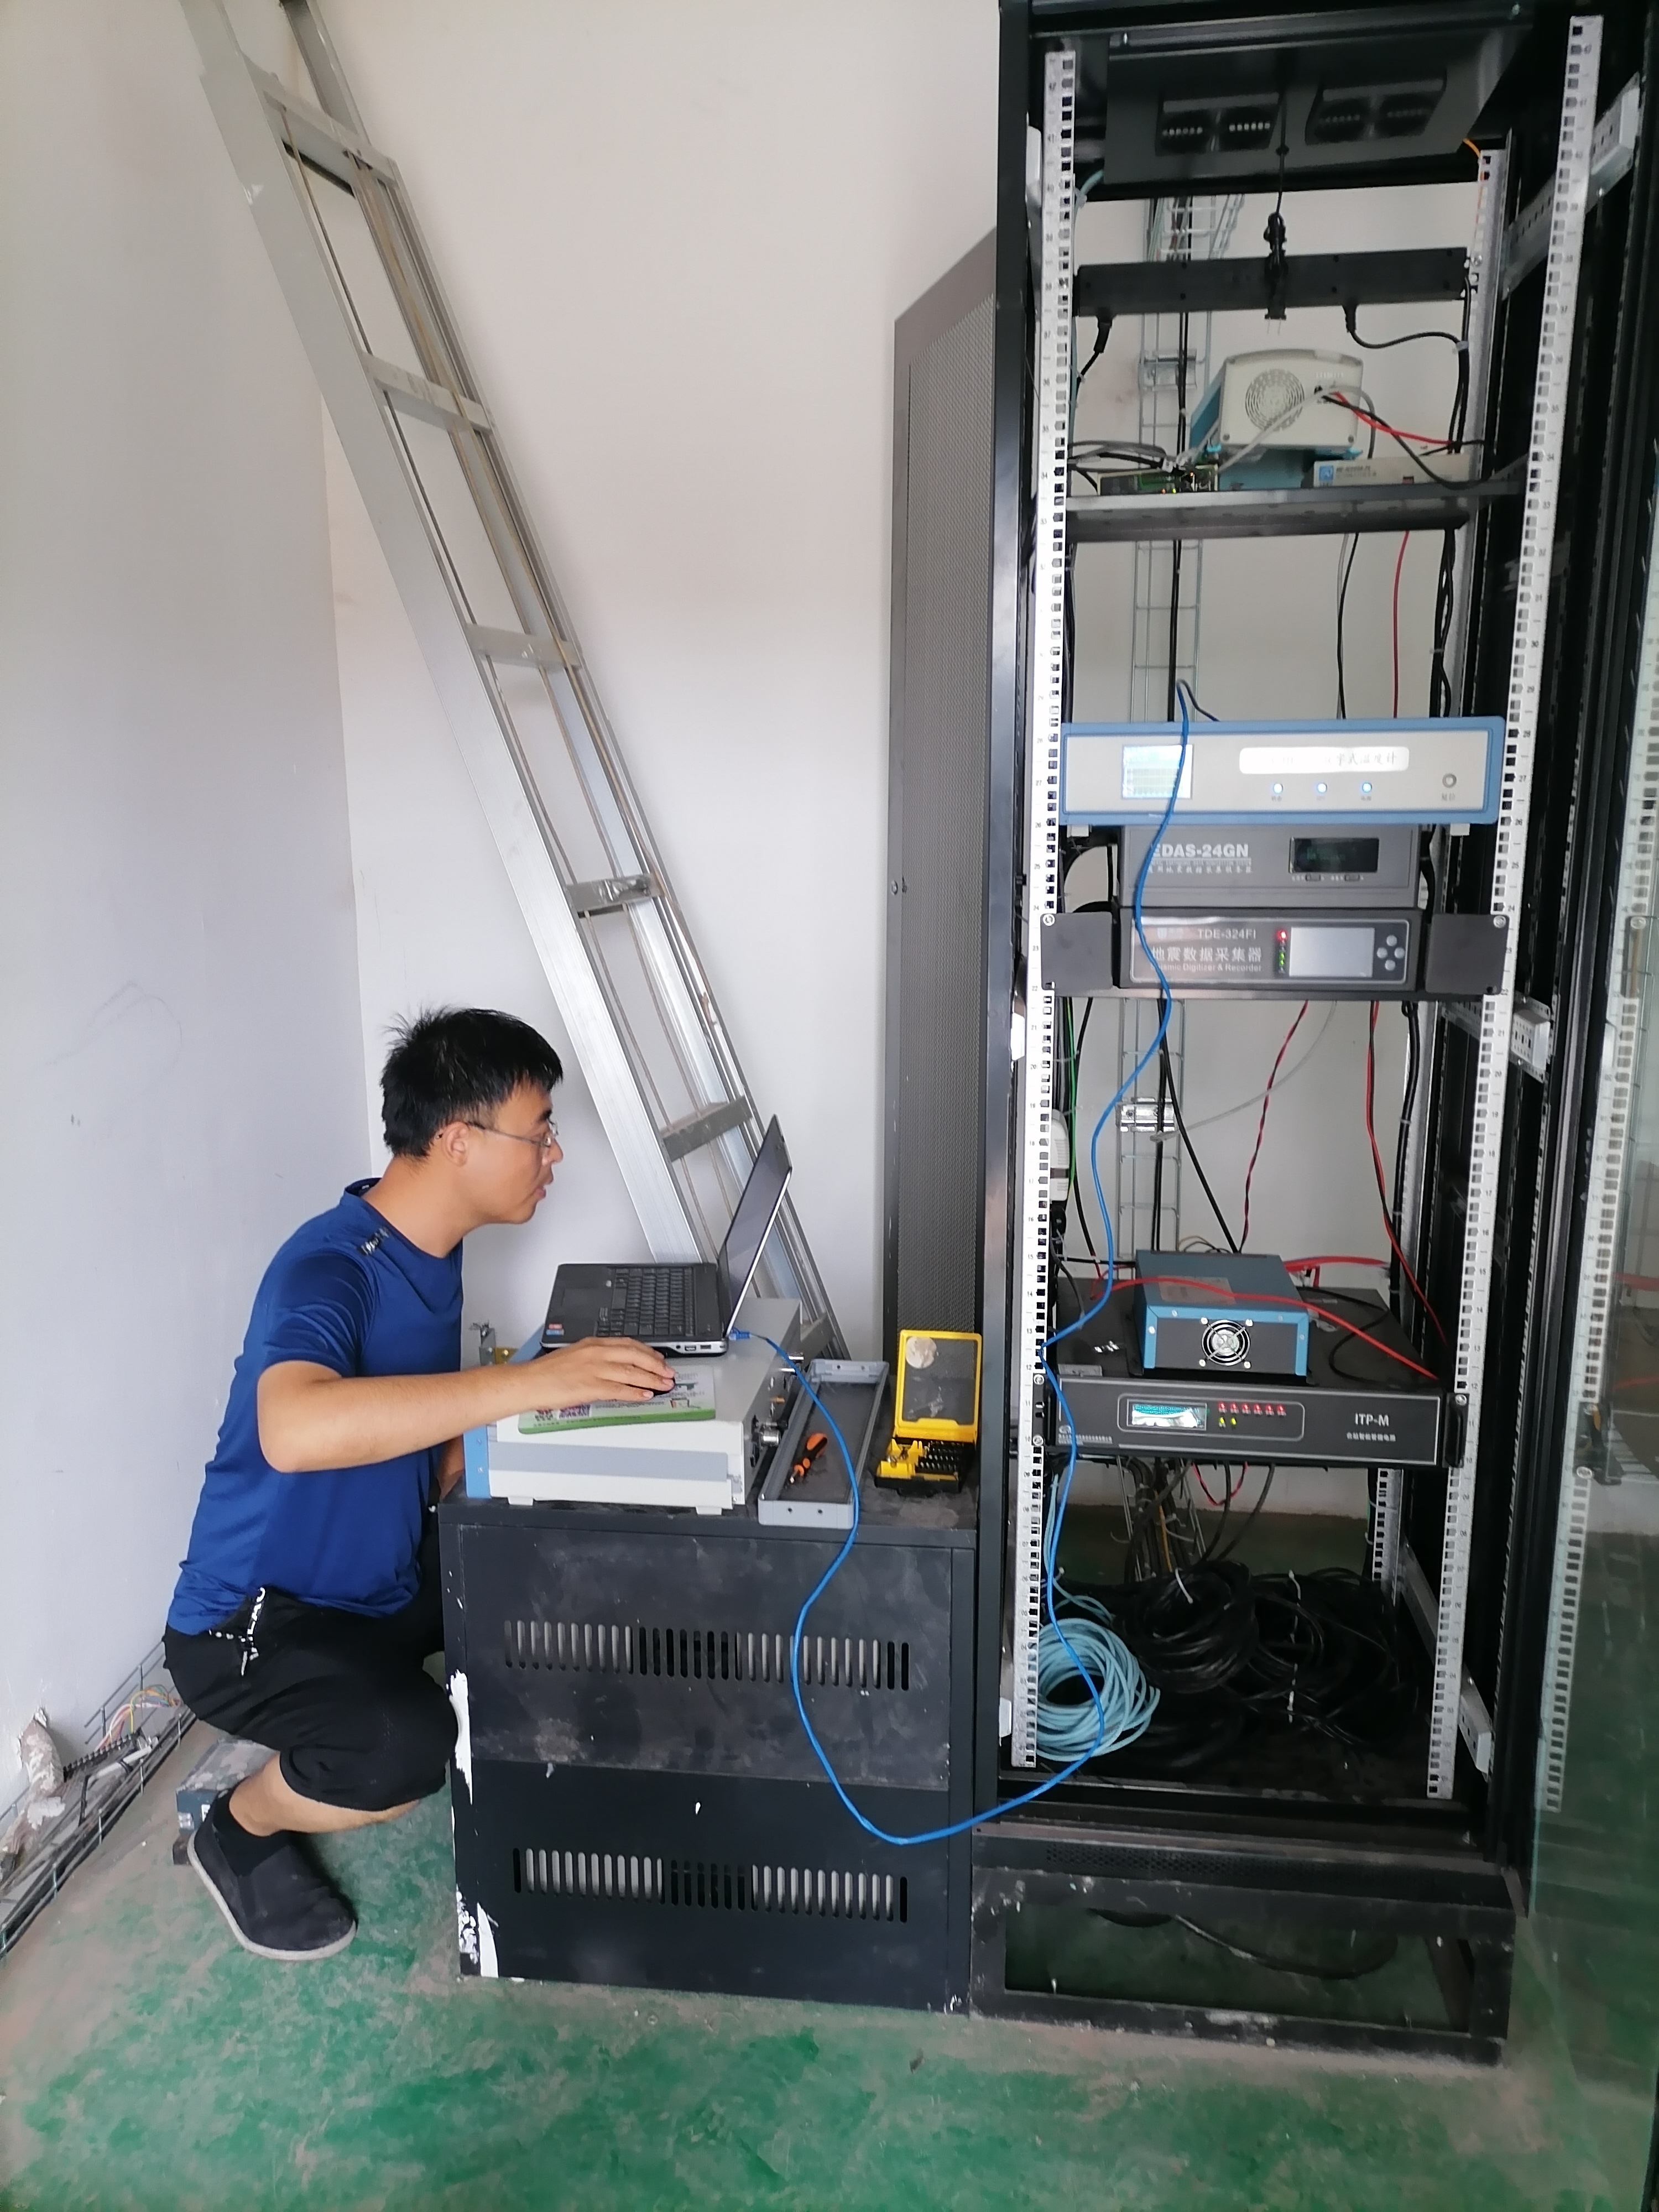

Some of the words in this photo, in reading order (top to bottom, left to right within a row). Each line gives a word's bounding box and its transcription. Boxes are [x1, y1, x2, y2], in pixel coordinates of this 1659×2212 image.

[1152, 946, 1262, 962] 地震数据采集器
[1183, 963, 1215, 972] Digitizer
[1225, 963, 1262, 972] Recorder
[1355, 1412, 1390, 1427] ITP-M
